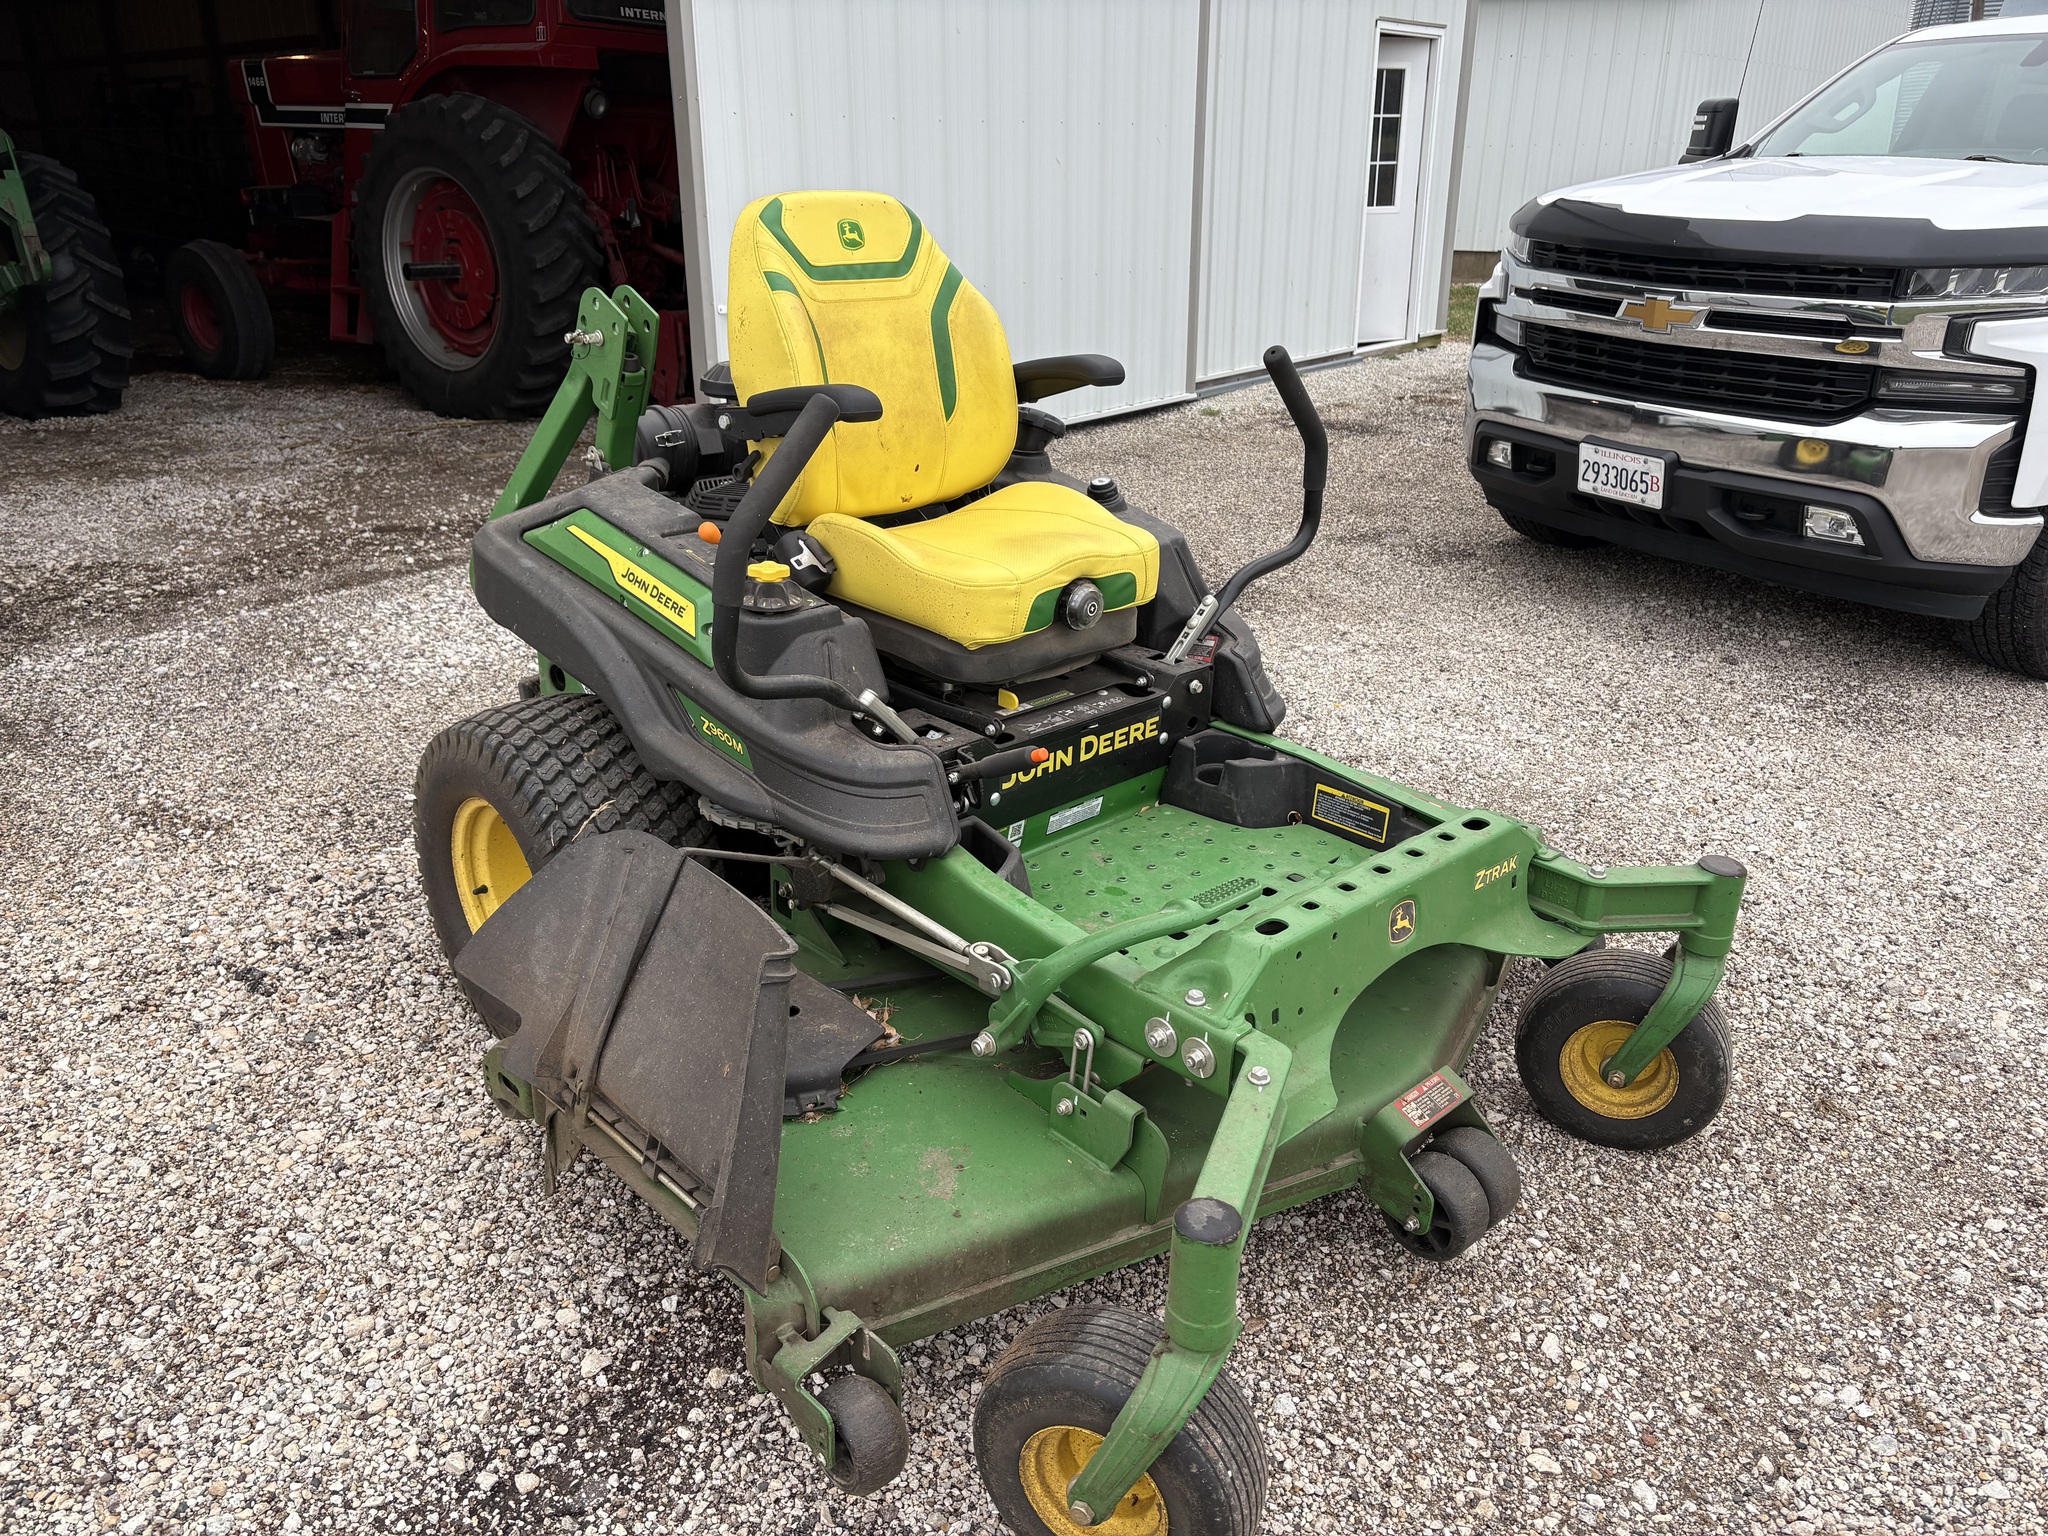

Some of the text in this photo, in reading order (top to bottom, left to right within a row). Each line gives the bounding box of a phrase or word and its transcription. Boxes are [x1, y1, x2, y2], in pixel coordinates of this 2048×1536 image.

[248, 77, 265, 87] 1466
[320, 113, 345, 123] INTER
[1600, 450, 1641, 464] ILLINOIS
[621, 567, 687, 618] JOHN DEERE
[700, 715, 744, 755] Z960M
[1079, 715, 1160, 762] DEERE
[1474, 854, 1518, 891] ZTRAK
